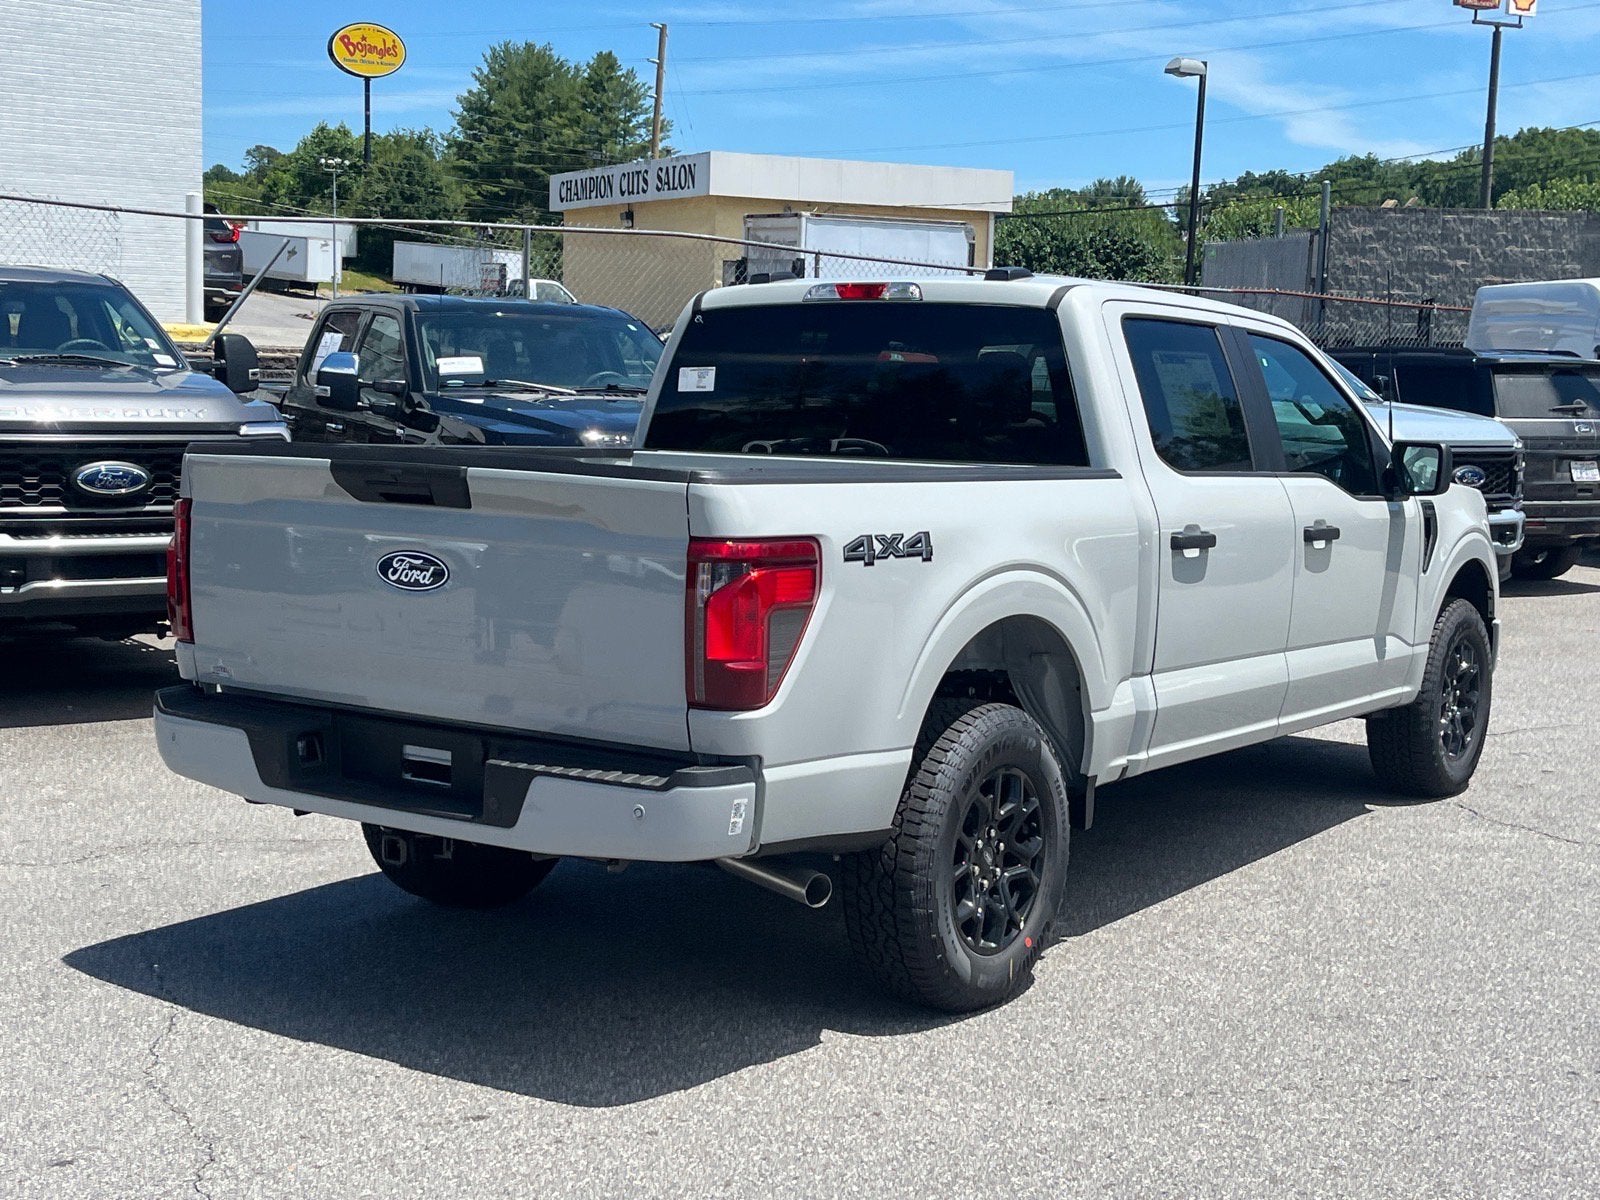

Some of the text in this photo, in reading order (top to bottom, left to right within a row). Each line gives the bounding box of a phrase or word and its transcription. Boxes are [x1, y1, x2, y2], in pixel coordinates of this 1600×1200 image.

[559, 163, 697, 203] CHAMPION CUTS SALON
[94, 471, 132, 488] Ford
[388, 556, 433, 585] Ford
